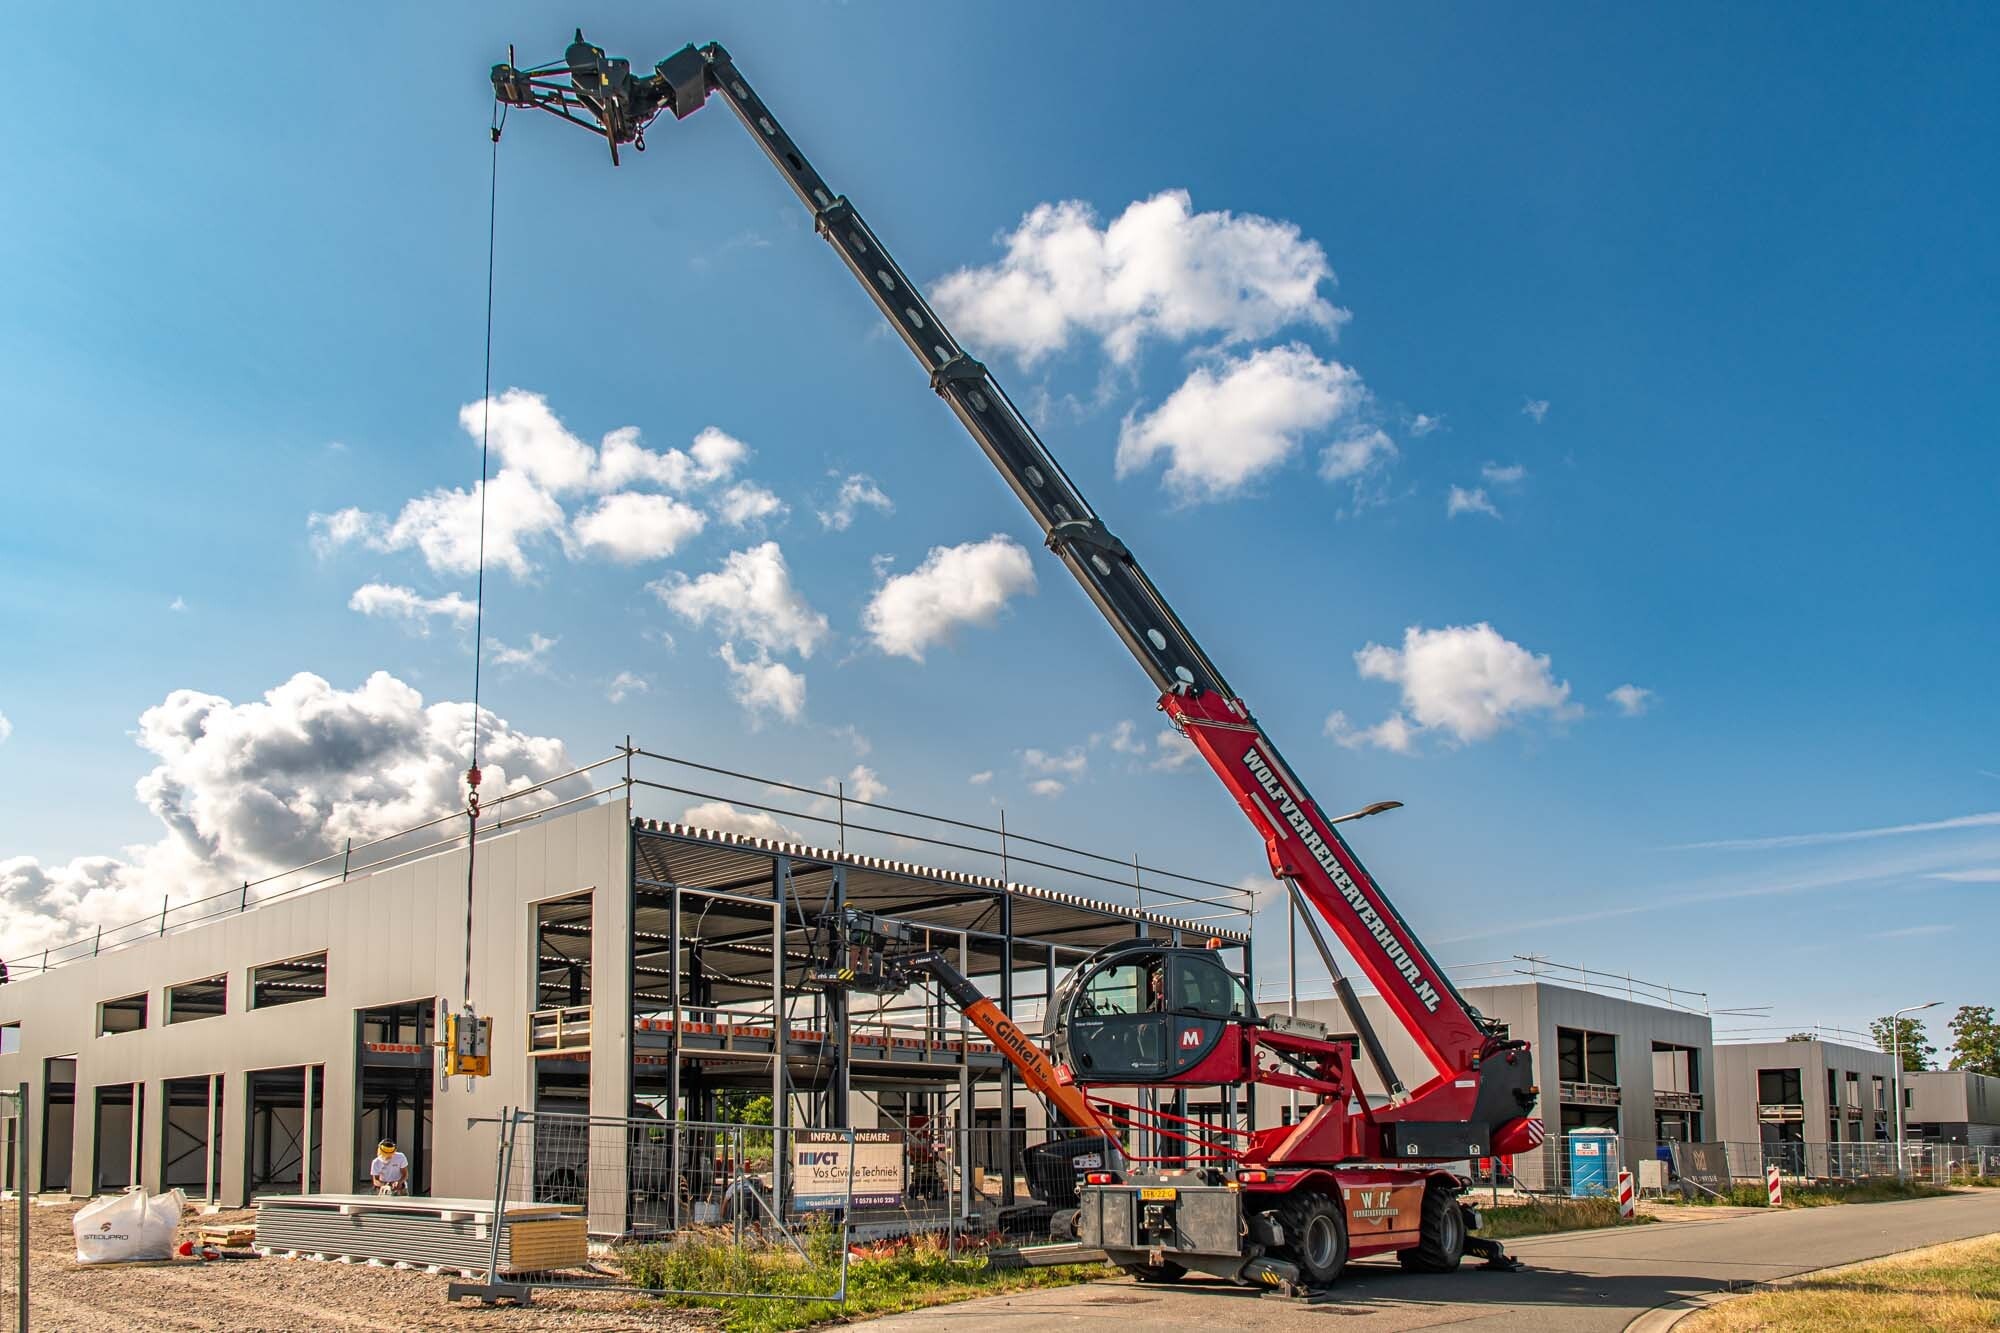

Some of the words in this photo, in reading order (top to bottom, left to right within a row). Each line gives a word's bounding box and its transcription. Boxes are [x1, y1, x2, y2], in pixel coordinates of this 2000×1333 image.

[1243, 748, 1441, 1013] WOLFVERREIKERVERHUUR.NL
[982, 1013, 994, 1026] van
[995, 1021, 1040, 1066] Ginkel
[1182, 1031, 1199, 1045] M
[810, 1132, 837, 1142] INFRA
[839, 1132, 890, 1142] ANNEMER:
[813, 1166, 829, 1177] Vos
[830, 1166, 861, 1177] Civile
[862, 1165, 898, 1177] Techniek
[1361, 1191, 1391, 1208] WLF
